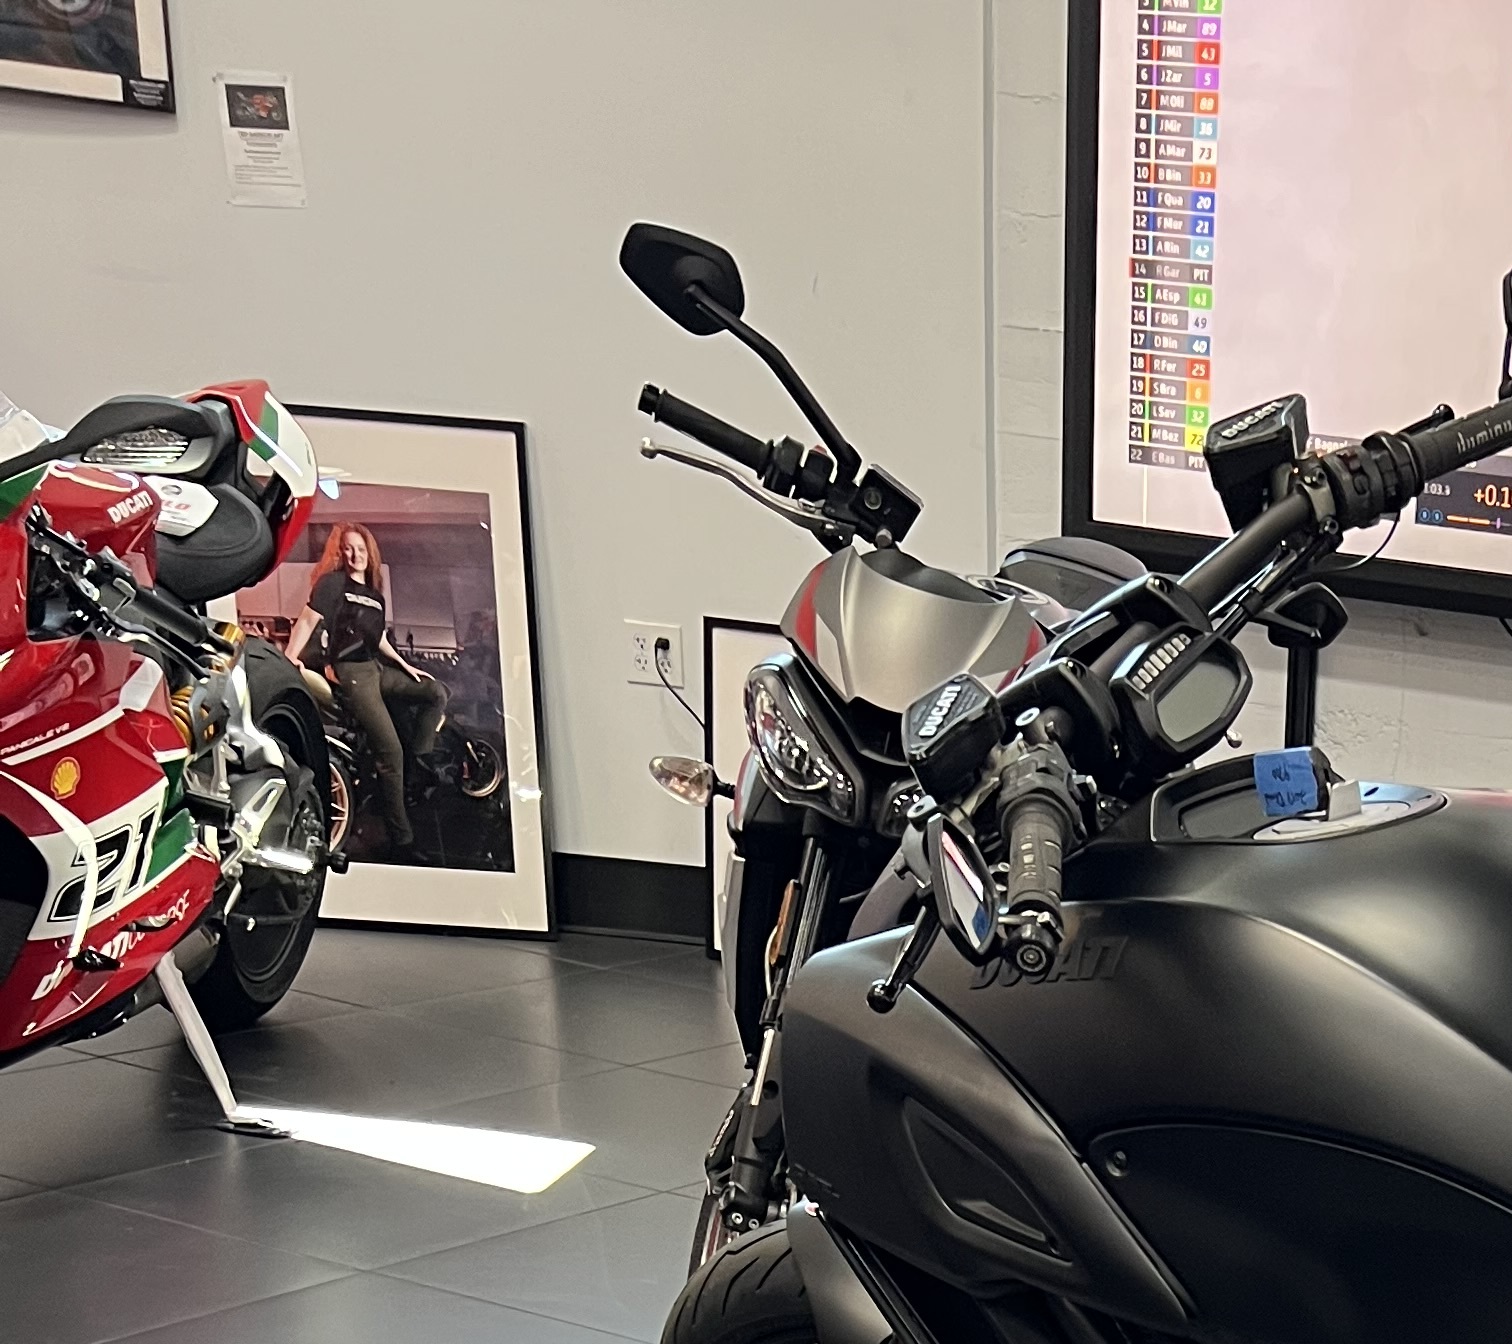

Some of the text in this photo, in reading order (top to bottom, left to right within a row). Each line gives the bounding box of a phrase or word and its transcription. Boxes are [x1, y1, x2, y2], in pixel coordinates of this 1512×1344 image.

[1142, 19, 1149, 31] 4
[1142, 43, 1149, 56] 5
[1141, 68, 1148, 81] 6
[1141, 93, 1147, 105] 7
[1140, 118, 1147, 130] 8
[1139, 142, 1146, 154] 9
[1136, 166, 1149, 178] 10
[1136, 191, 1147, 203] 11
[1135, 215, 1147, 227] 12
[1135, 239, 1147, 251] 13
[1135, 263, 1146, 275] 14
[1134, 286, 1146, 299] 15
[1134, 310, 1145, 322] 16
[1133, 333, 1145, 345] 17
[1132, 357, 1144, 369] 18
[1132, 380, 1144, 392] 19
[1131, 403, 1143, 415] 20
[1221, 401, 1284, 440] DUCATI
[1131, 426, 1142, 438] 21
[1130, 449, 1143, 460] 22
[107, 491, 153, 523] DUCATI
[918, 685, 961, 736] DUCATI
[47, 803, 164, 923] 21
